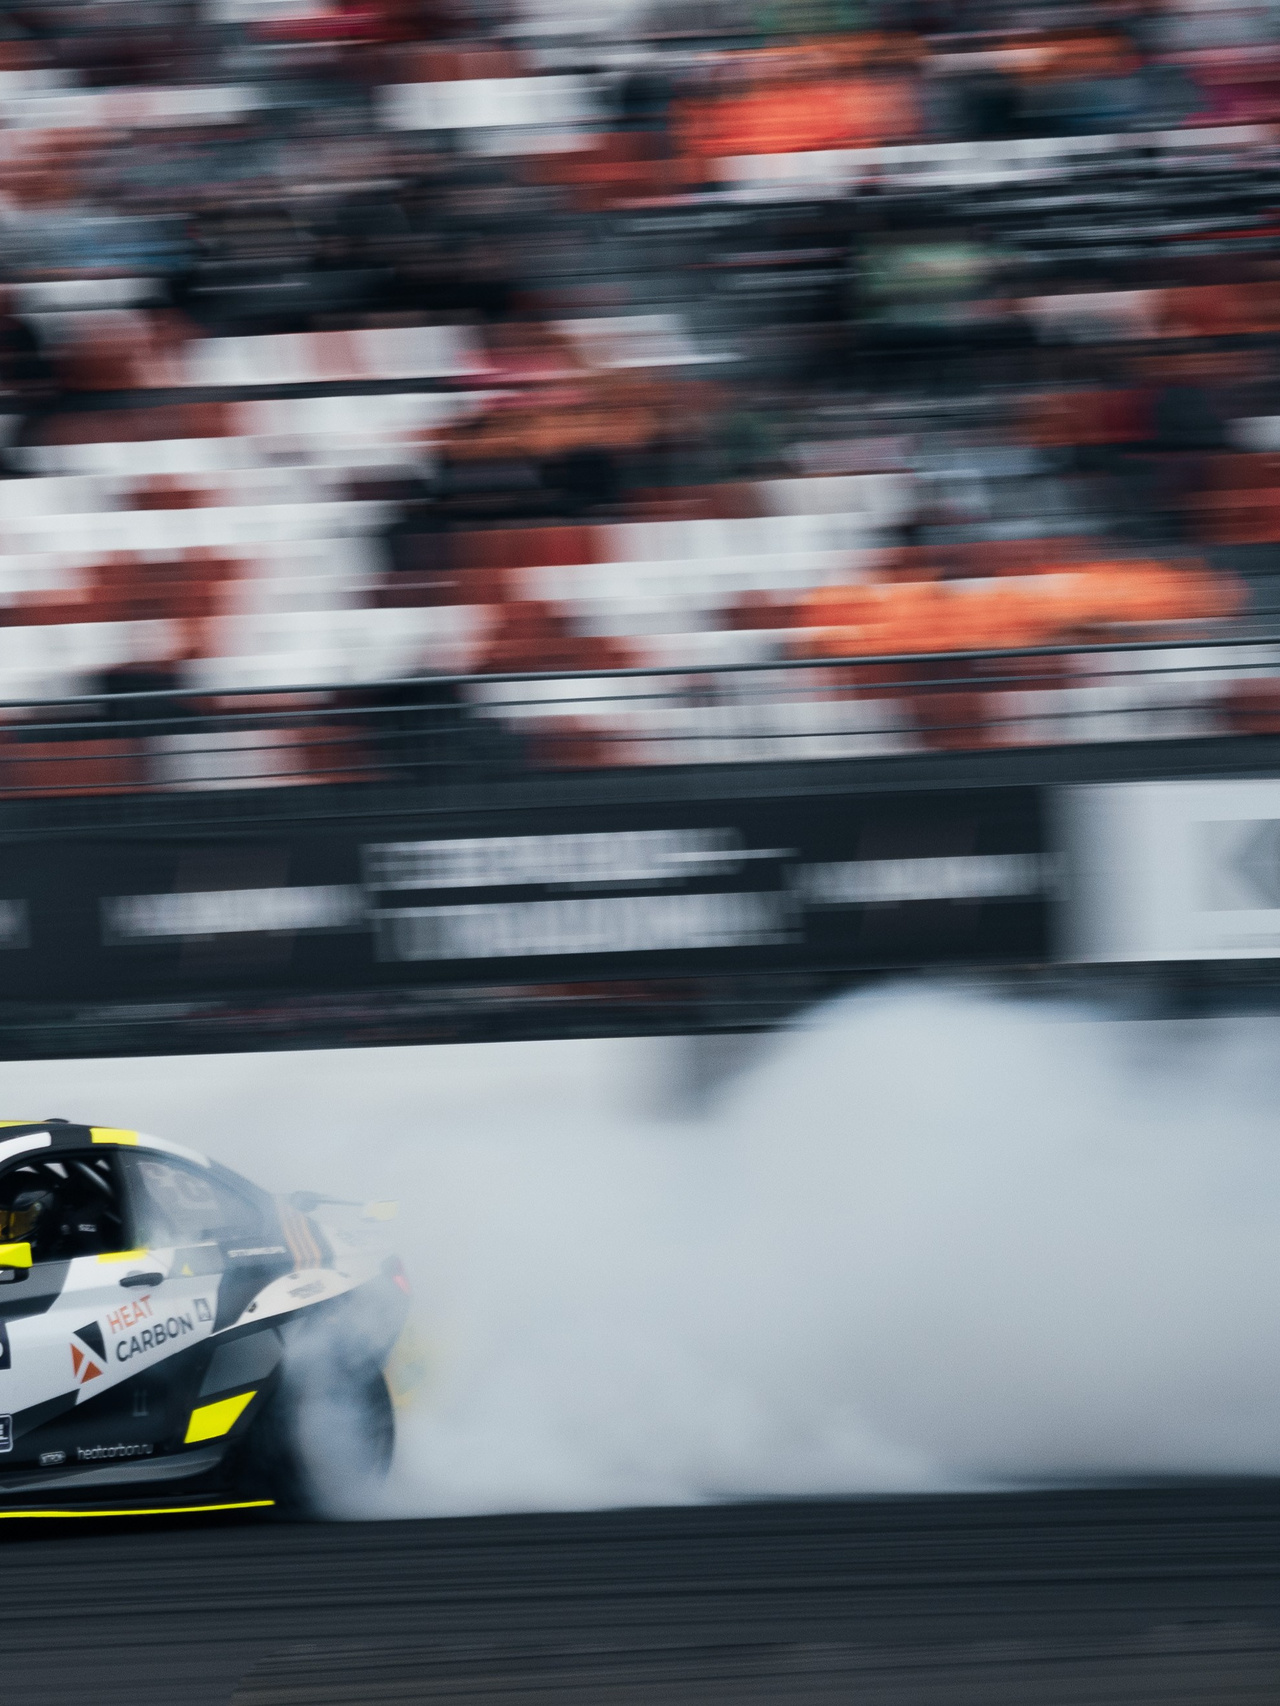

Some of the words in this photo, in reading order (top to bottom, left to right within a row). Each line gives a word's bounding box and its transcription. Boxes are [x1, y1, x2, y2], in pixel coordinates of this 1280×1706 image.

[106, 1294, 153, 1334] HEAT
[116, 1313, 194, 1363] CARBON
[77, 1443, 153, 1460] heatcarbon.ru
